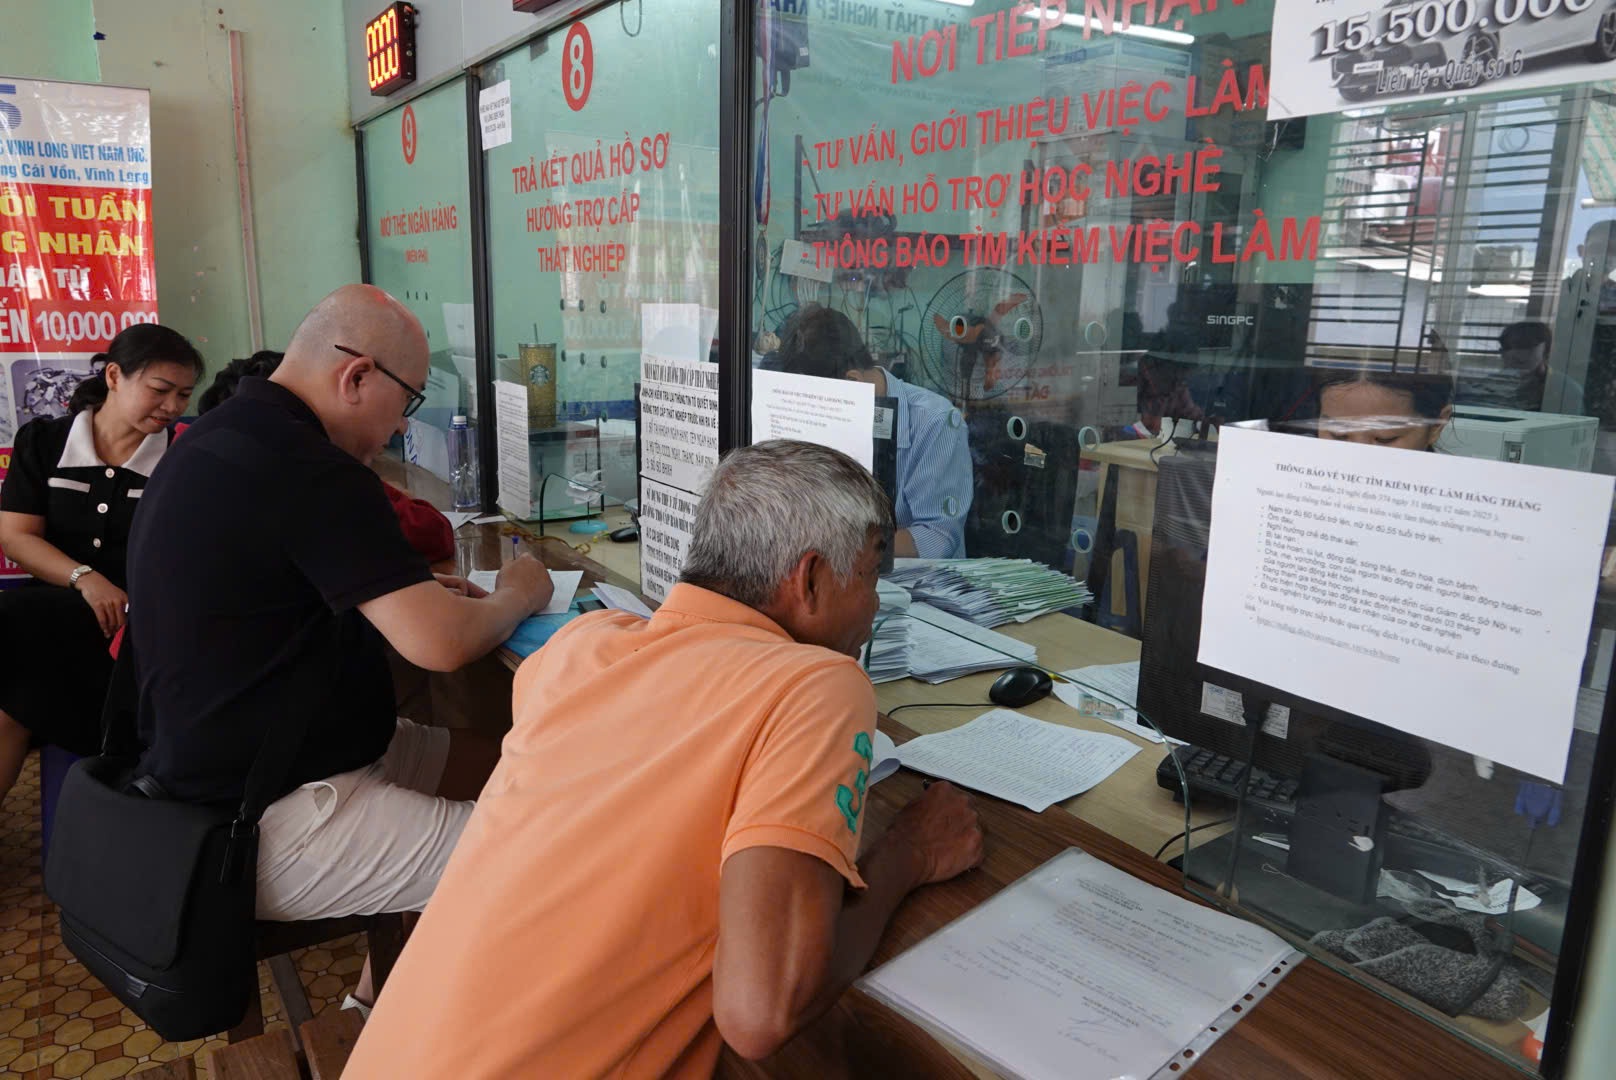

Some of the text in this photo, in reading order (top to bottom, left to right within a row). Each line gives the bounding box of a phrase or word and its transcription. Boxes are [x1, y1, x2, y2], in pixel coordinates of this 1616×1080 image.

[570, 34, 585, 100] 8
[891, 24, 958, 85] NƠI
[1511, 48, 1523, 75] 6
[815, 58, 1269, 171] TƯ VẤN, GIỚI THIỆU VIỆC LÀM
[37, 141, 67, 159] LONG
[71, 143, 95, 161] VIET
[512, 131, 671, 195] TRẢ KẾT QUẢ HỒ SƠ
[814, 137, 1224, 222] TƯ VẤN HỖ TRỢ HỌC NGHỀ
[48, 191, 147, 222] TUẦN
[432, 201, 457, 232] HÀNG
[527, 188, 640, 233] HƯỞNG TRỢ CẤP
[38, 229, 144, 257] NHÂN
[537, 240, 626, 279] THẤT NGHIỆP
[812, 208, 1321, 273] THÔNG BÁO TÌM KIẾM VIỆC LÀM
